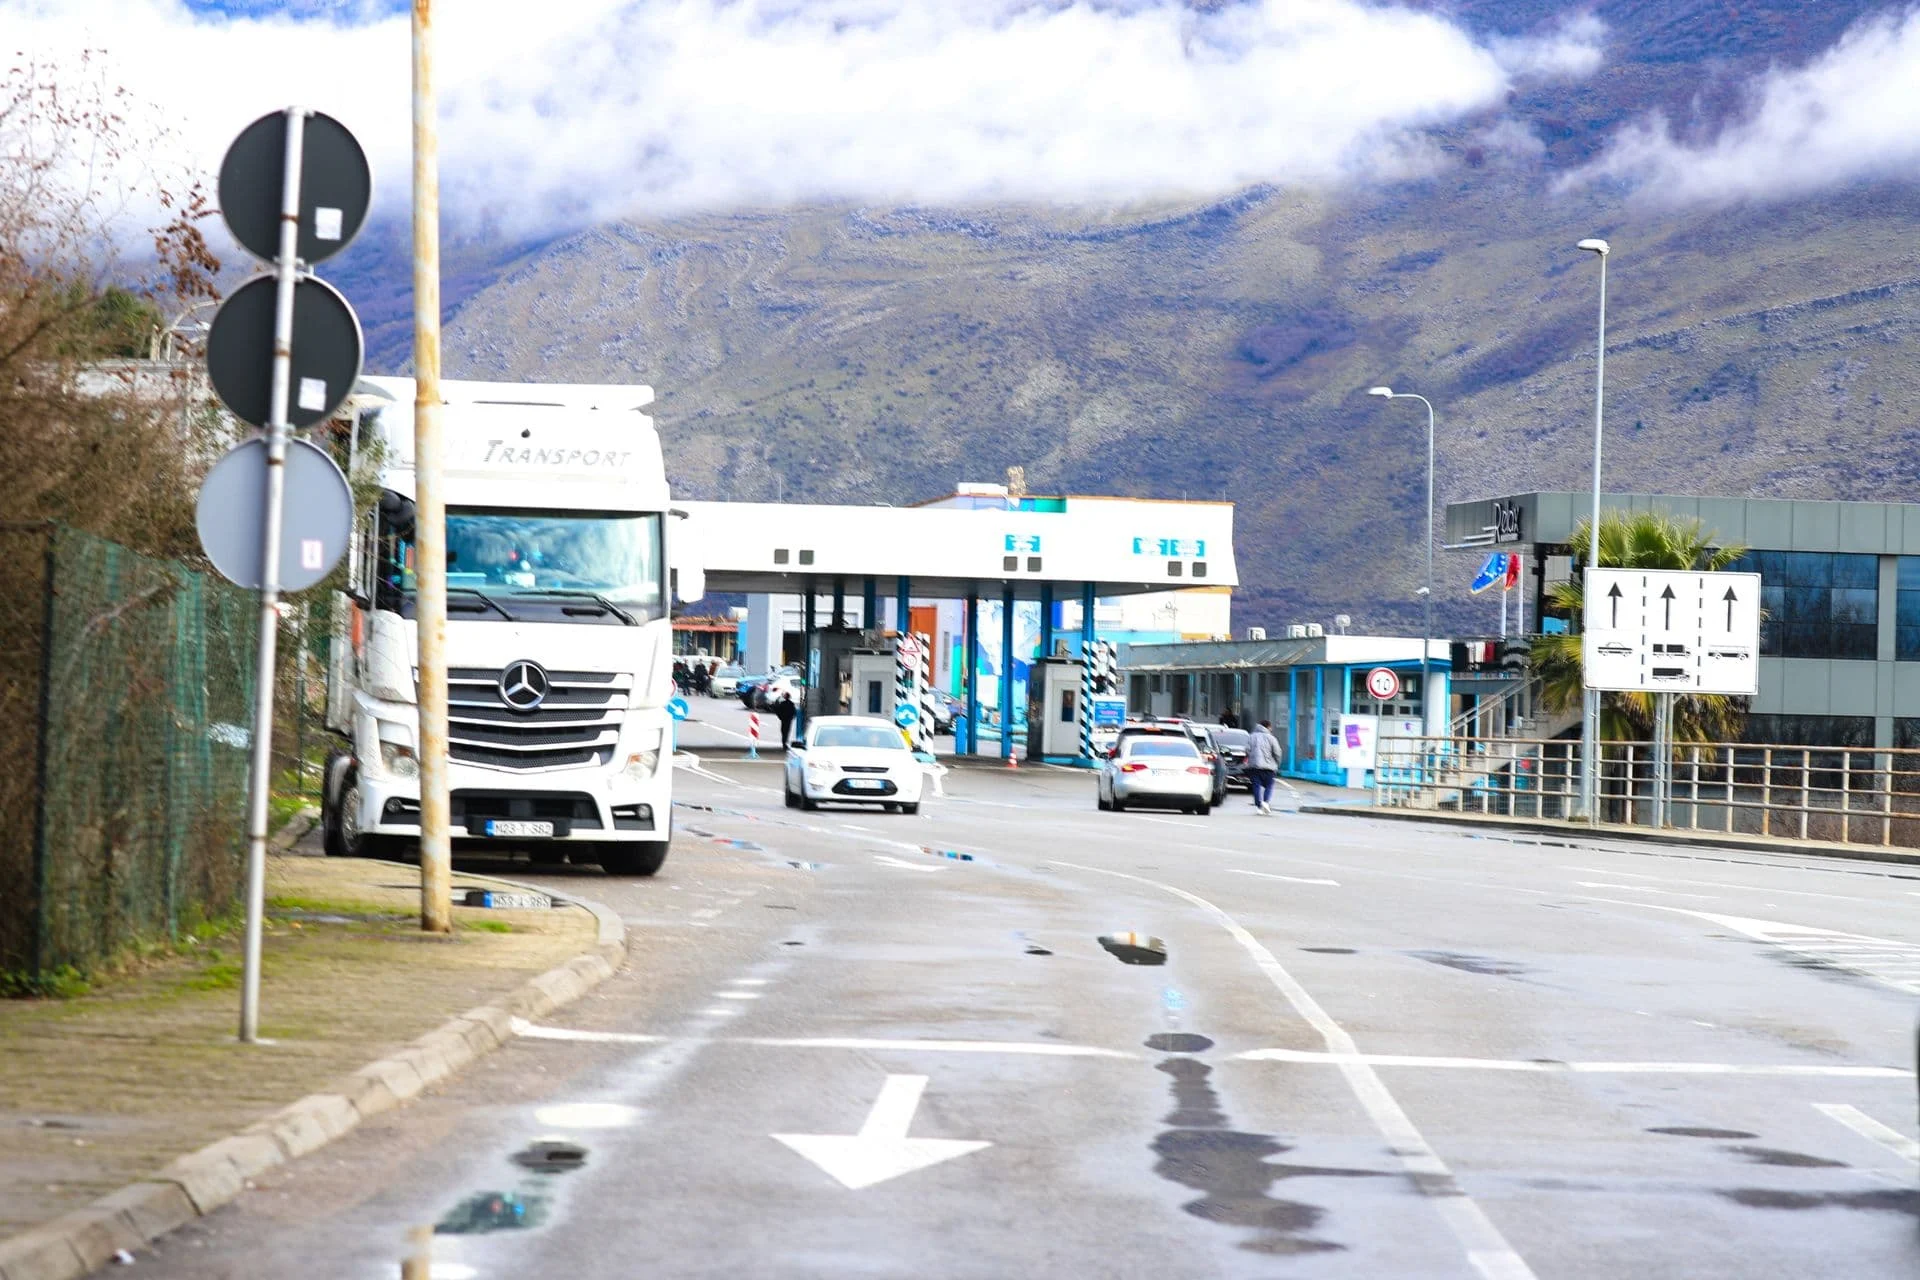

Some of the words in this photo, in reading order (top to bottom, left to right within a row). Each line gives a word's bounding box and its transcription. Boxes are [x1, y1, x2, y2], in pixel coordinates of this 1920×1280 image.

[483, 439, 632, 467] TRANSPORT
[1494, 499, 1520, 543] Relax
[1376, 678, 1391, 691] 10
